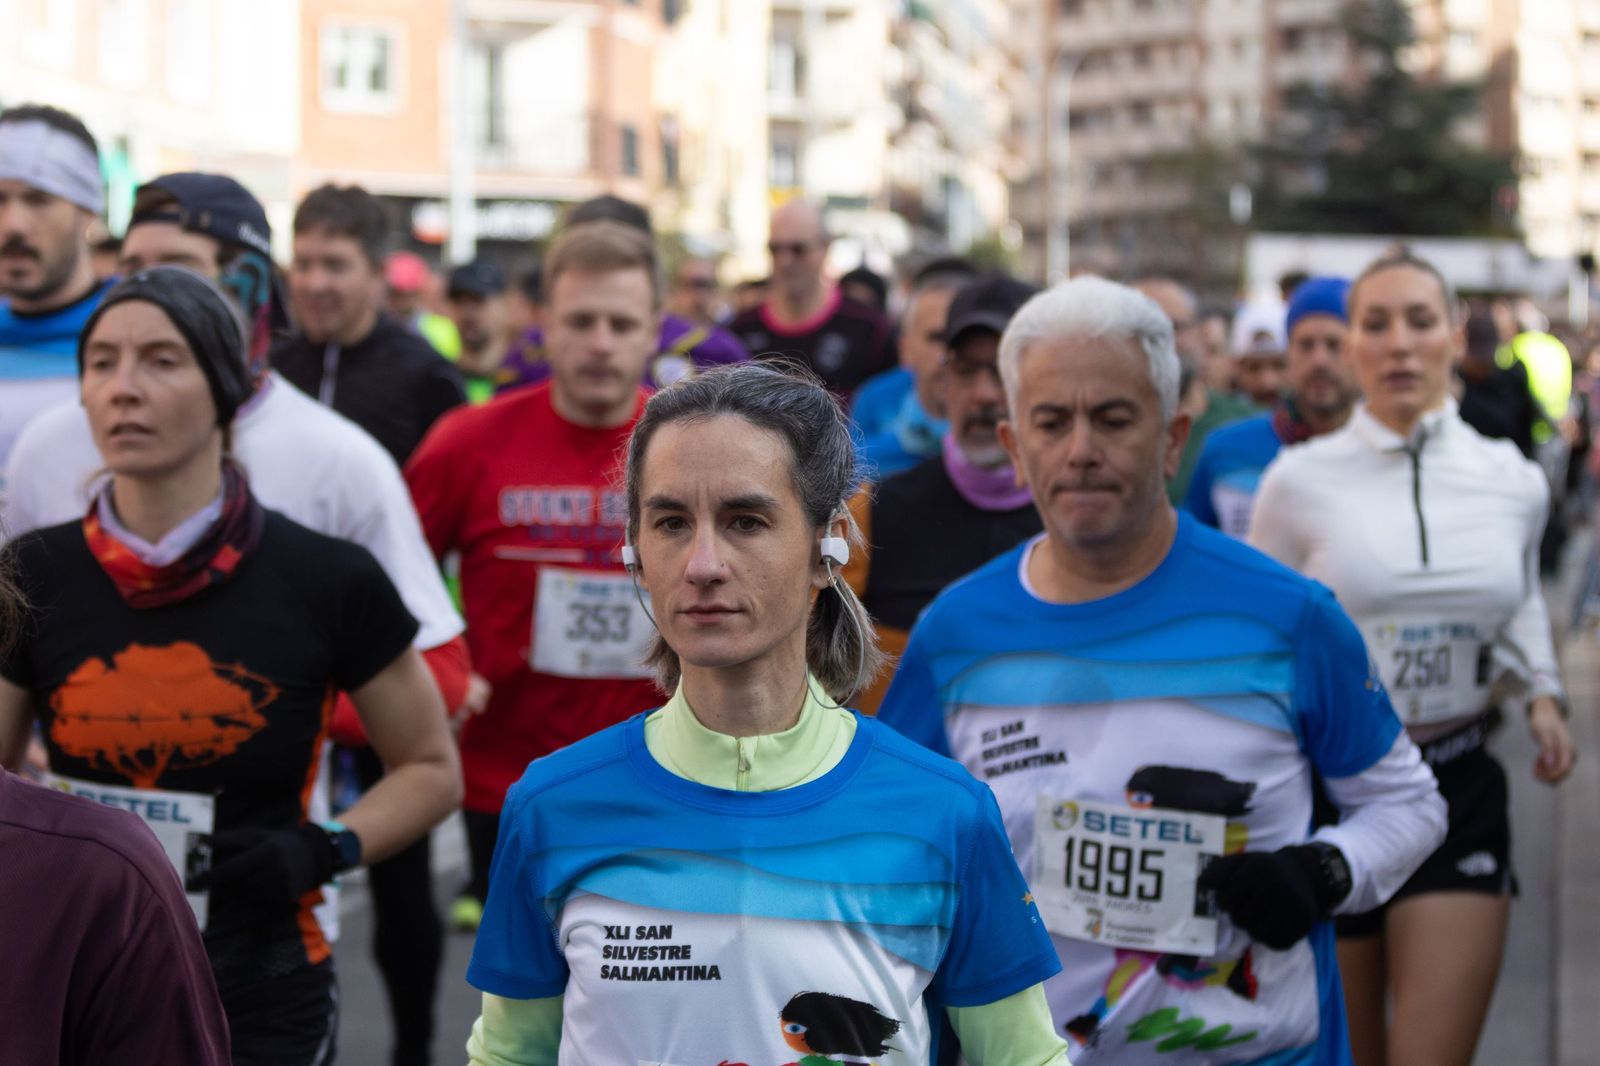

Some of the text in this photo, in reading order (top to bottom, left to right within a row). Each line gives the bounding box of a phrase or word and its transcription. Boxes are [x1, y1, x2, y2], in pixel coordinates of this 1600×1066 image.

[565, 602, 632, 643] 353
[1393, 645, 1452, 690] 250
[1001, 721, 1024, 737] SAN
[984, 751, 1067, 779] SALMANTINA
[1083, 809, 1204, 845] SETEL
[1064, 836, 1165, 903] 1995
[604, 925, 673, 940] XLI SAN
[602, 944, 692, 961] SILVESTRE
[600, 964, 721, 982] SALMANTINA
